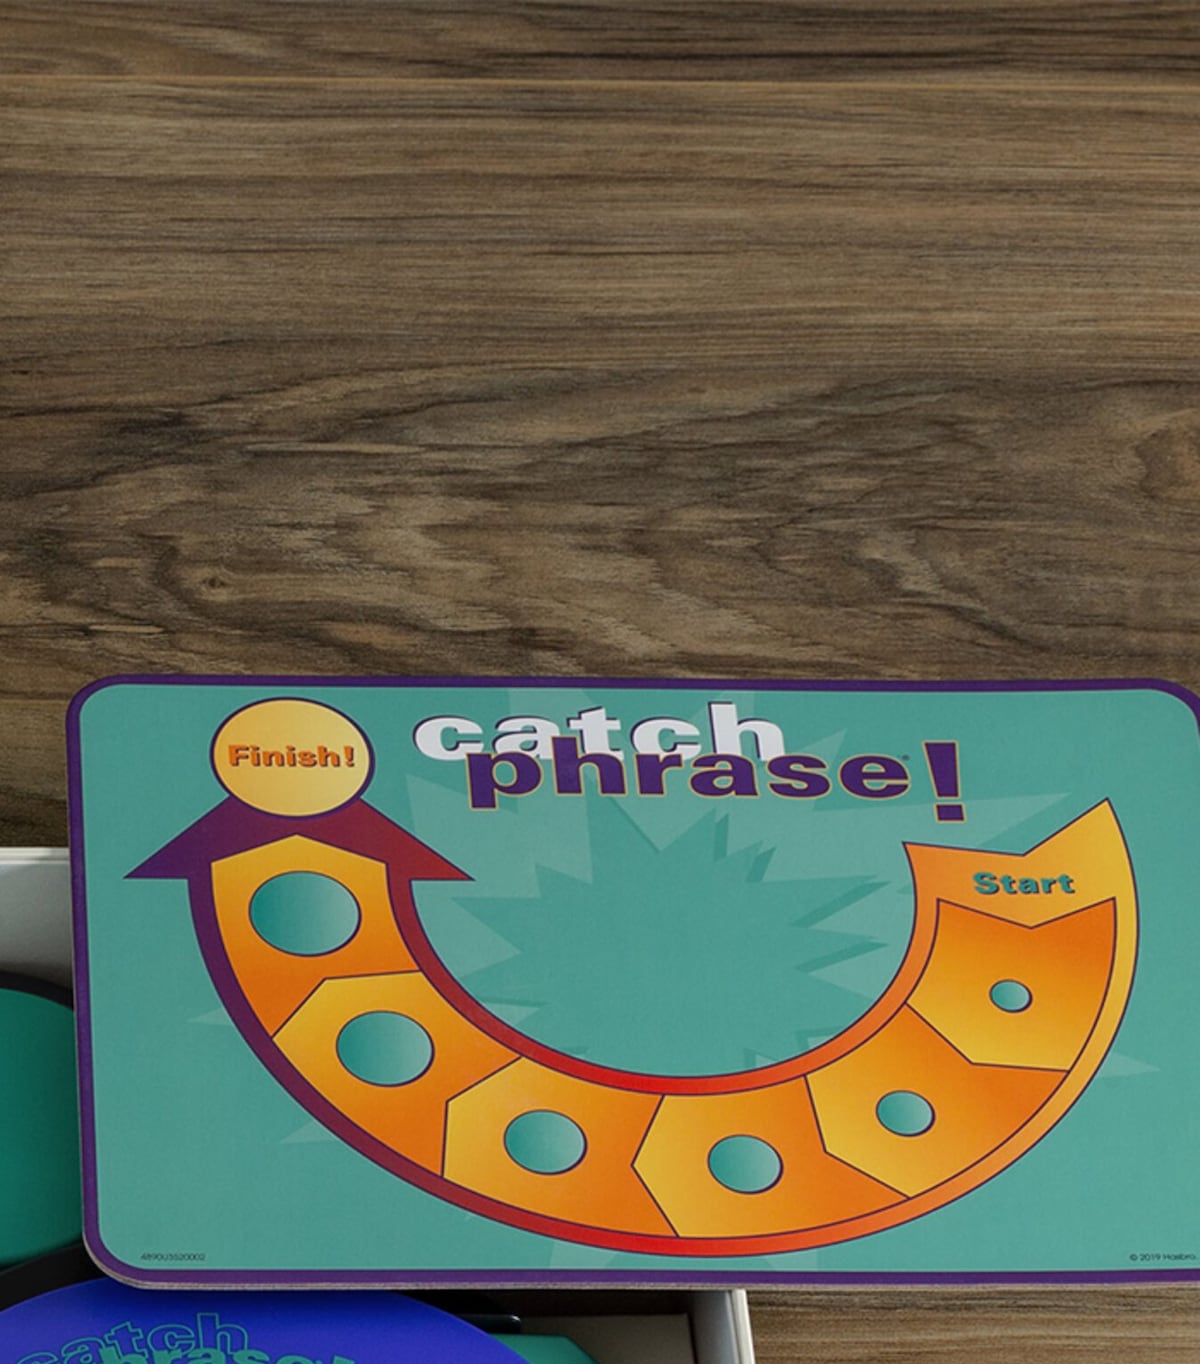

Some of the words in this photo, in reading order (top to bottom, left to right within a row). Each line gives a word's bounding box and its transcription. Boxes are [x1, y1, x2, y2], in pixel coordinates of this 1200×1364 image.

[412, 701, 786, 761] catch
[228, 744, 355, 767] Finish!
[465, 735, 967, 822] phrase!
[973, 871, 1076, 895] Start
